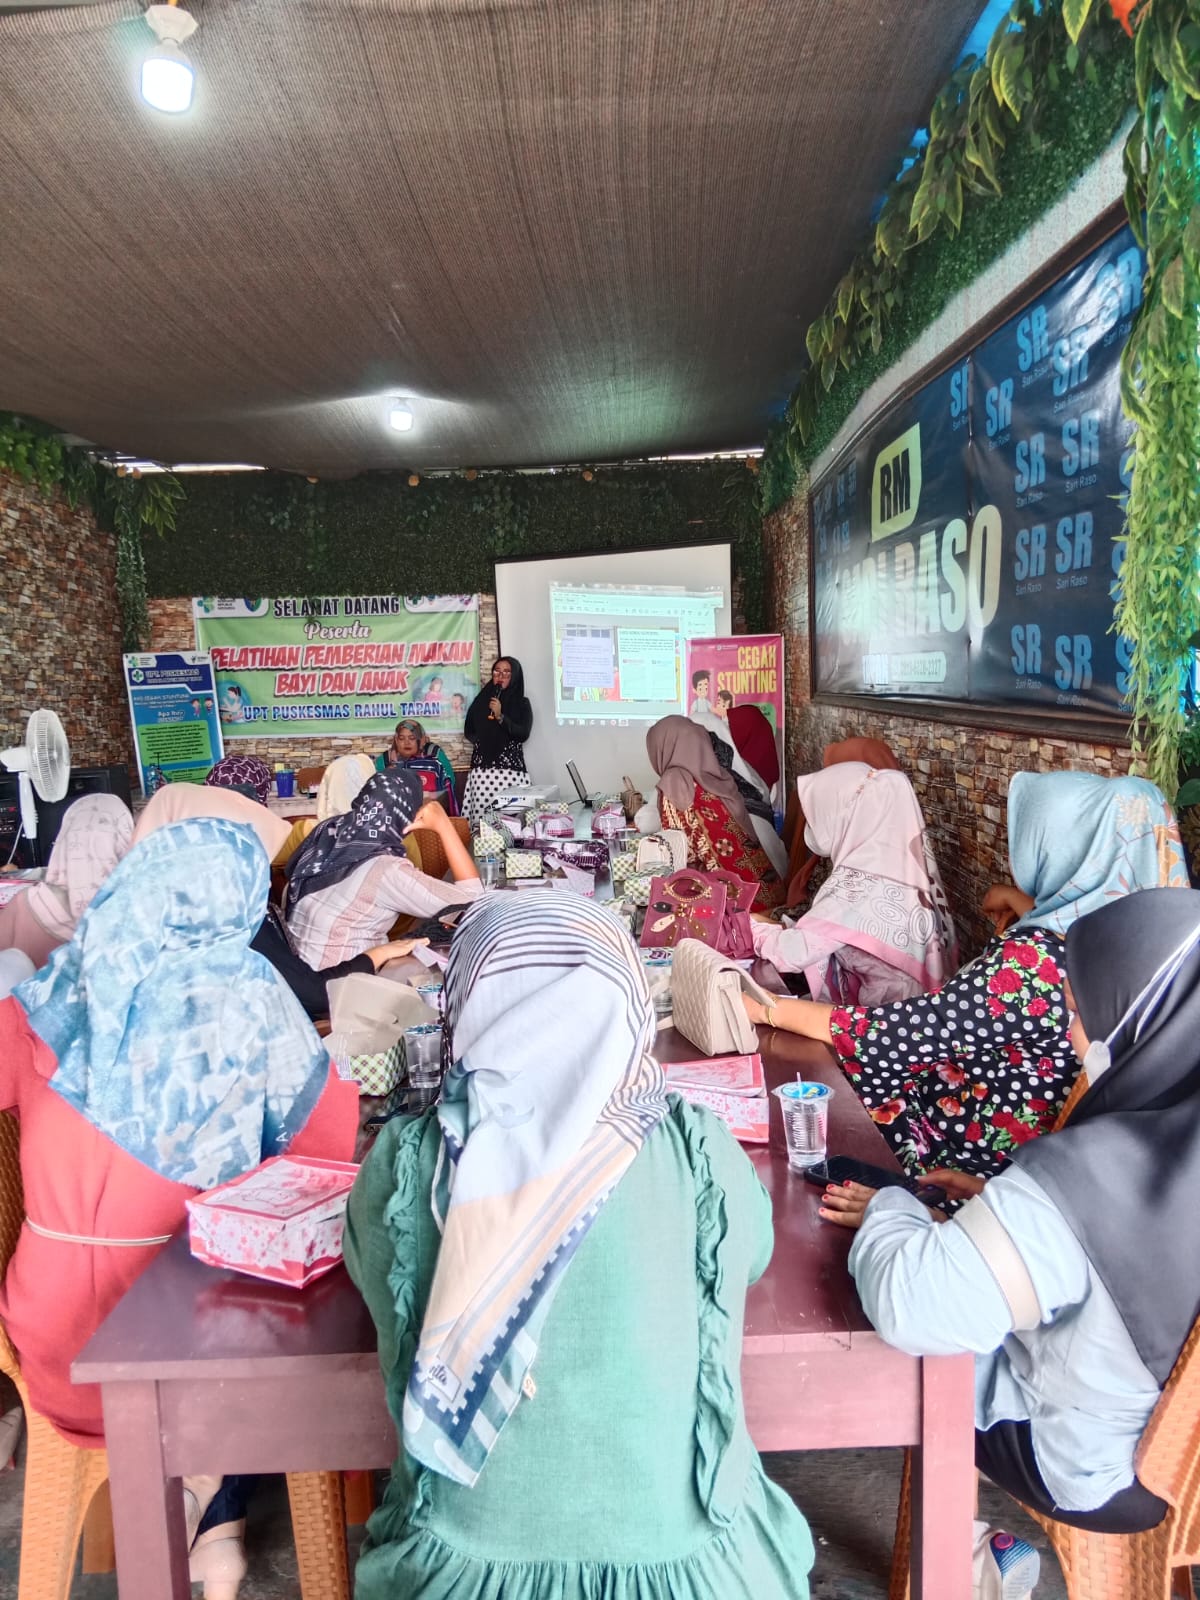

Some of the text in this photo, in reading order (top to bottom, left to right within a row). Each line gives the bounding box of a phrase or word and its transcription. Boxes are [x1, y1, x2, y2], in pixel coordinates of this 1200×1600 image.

[1096, 247, 1141, 326] SR
[1017, 304, 1050, 372] SR
[1053, 325, 1089, 397] SR
[986, 377, 1014, 437] SR
[1015, 432, 1046, 493] SR
[1062, 409, 1100, 476] SR
[879, 448, 911, 524] RM
[1079, 474, 1097, 489] Raso
[1014, 524, 1047, 581] SR
[1055, 511, 1094, 574] SR
[344, 597, 400, 615] DATANG
[1027, 582, 1042, 593] Raso
[1070, 575, 1088, 587] Raso
[210, 641, 474, 670] PELATIHAN PEMBERIAN MAKAN
[304, 620, 371, 640] Peserta
[1011, 623, 1042, 675] SR
[275, 670, 410, 696] BAYI DAN ANAK
[717, 670, 777, 694] STUNTING
[737, 645, 777, 669] CEGAH
[1055, 634, 1093, 690] SR
[243, 702, 441, 721] UPT PUSKESMAS RAHUL TAPAN
